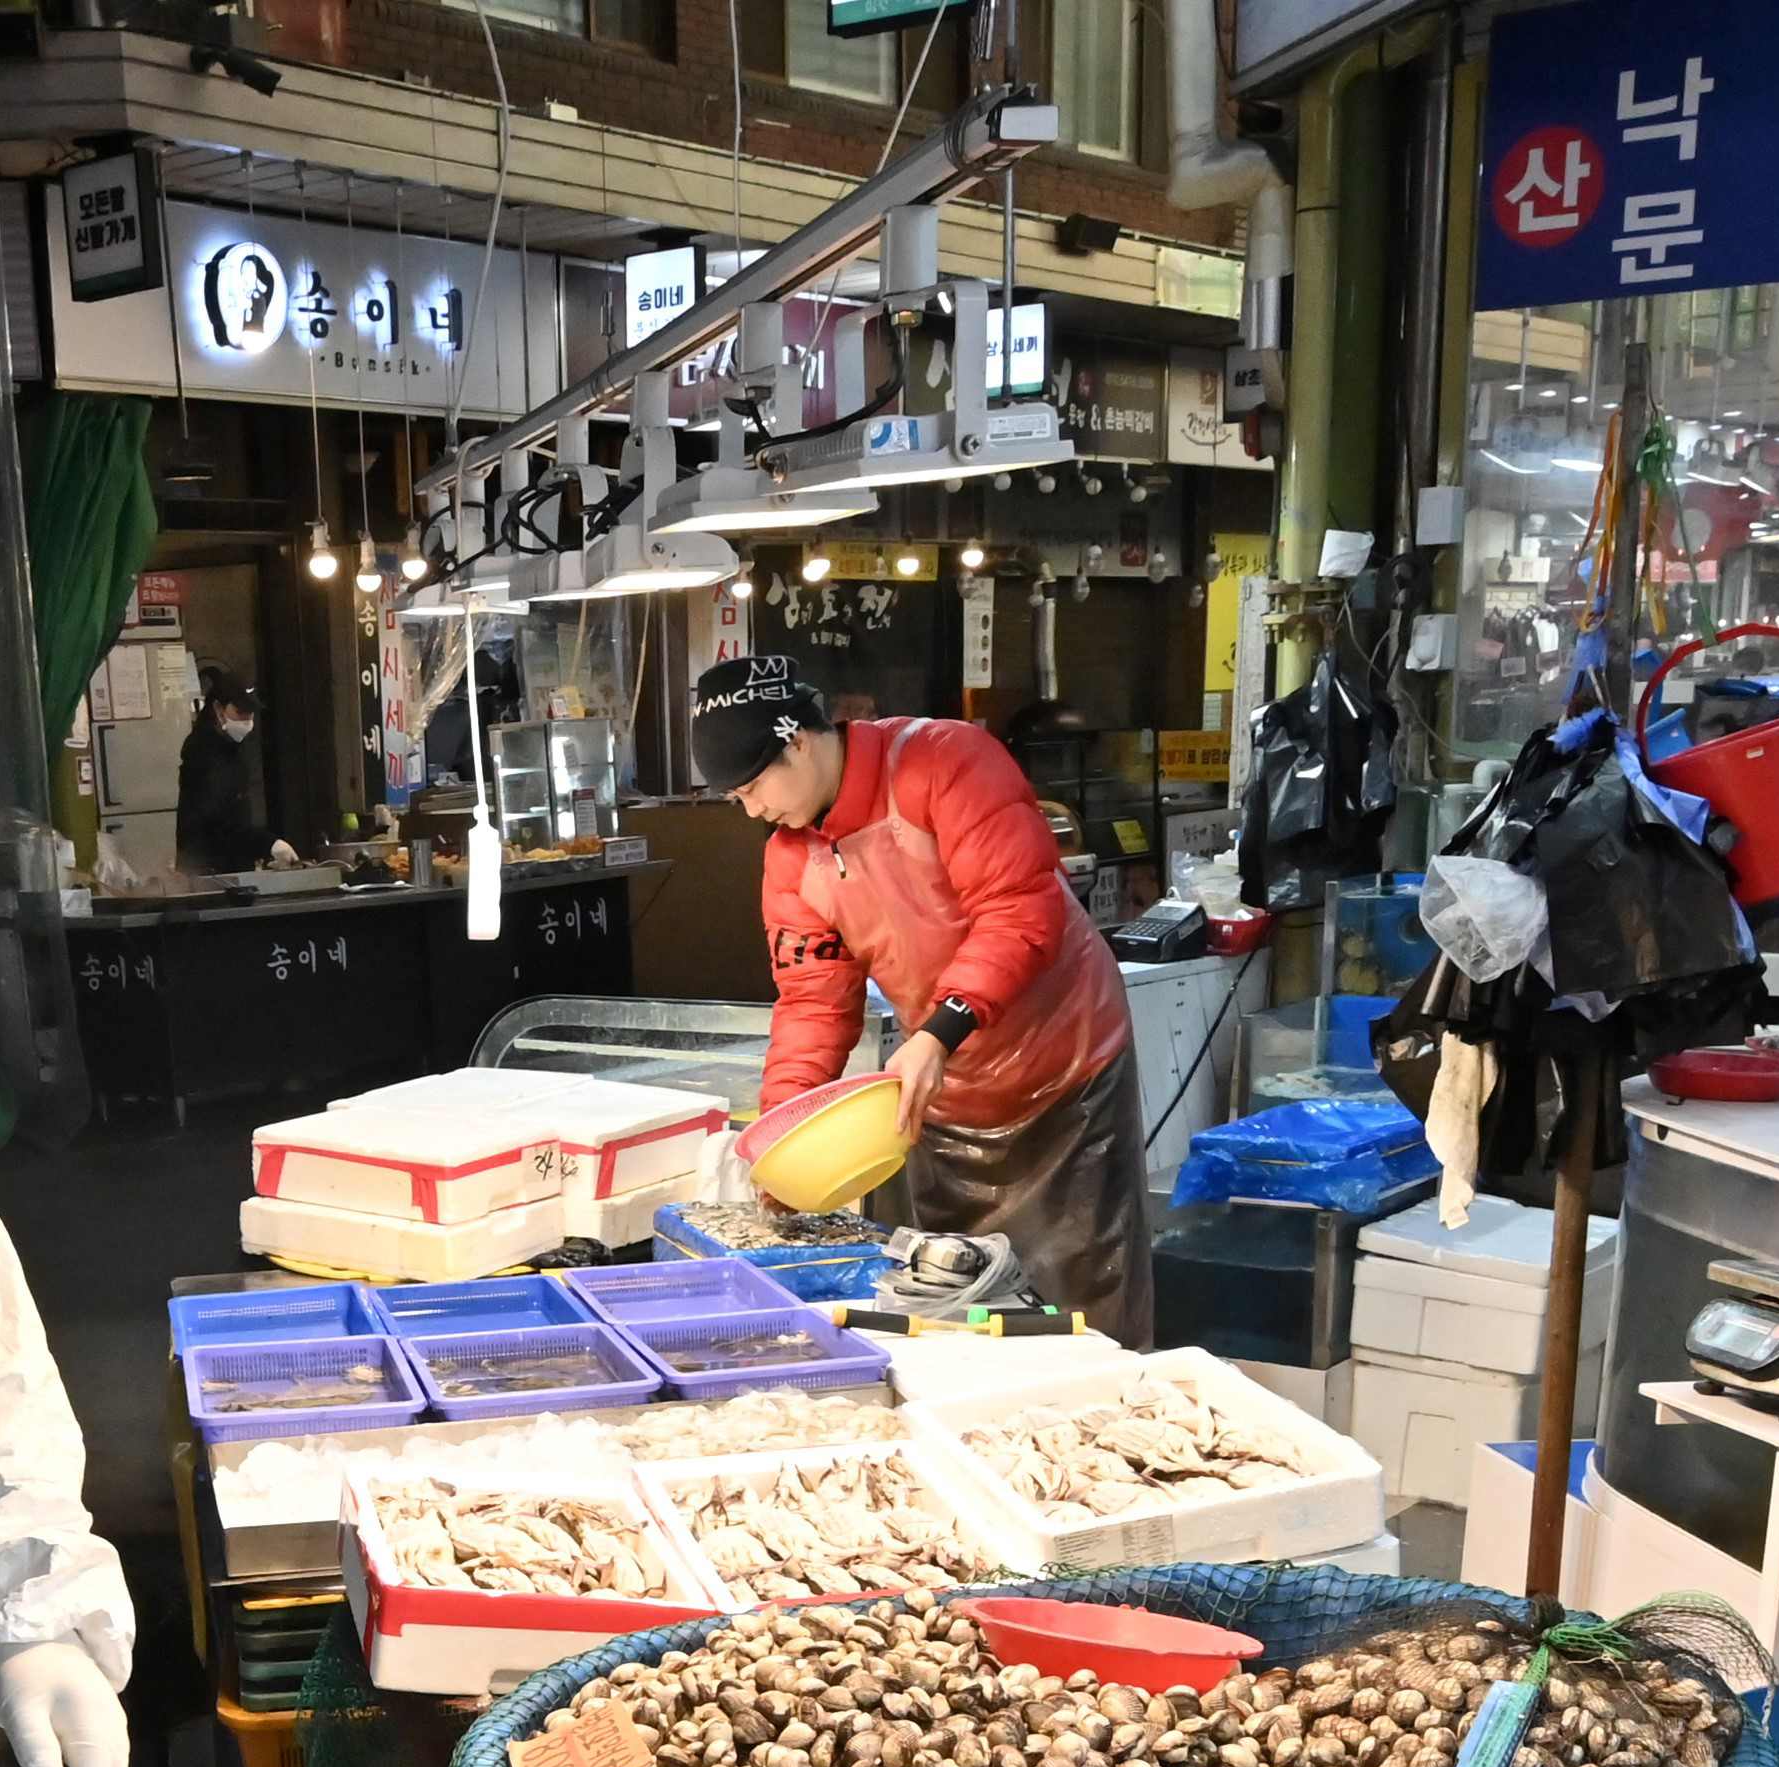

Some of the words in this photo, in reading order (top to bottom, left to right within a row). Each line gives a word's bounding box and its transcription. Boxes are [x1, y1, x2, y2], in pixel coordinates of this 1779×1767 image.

[1504, 142, 1591, 235] 산
[638, 285, 683, 311] 송이네
[537, 897, 608, 945] 송이네
[79, 953, 155, 991] 송이네
[266, 936, 347, 980] 송이네
